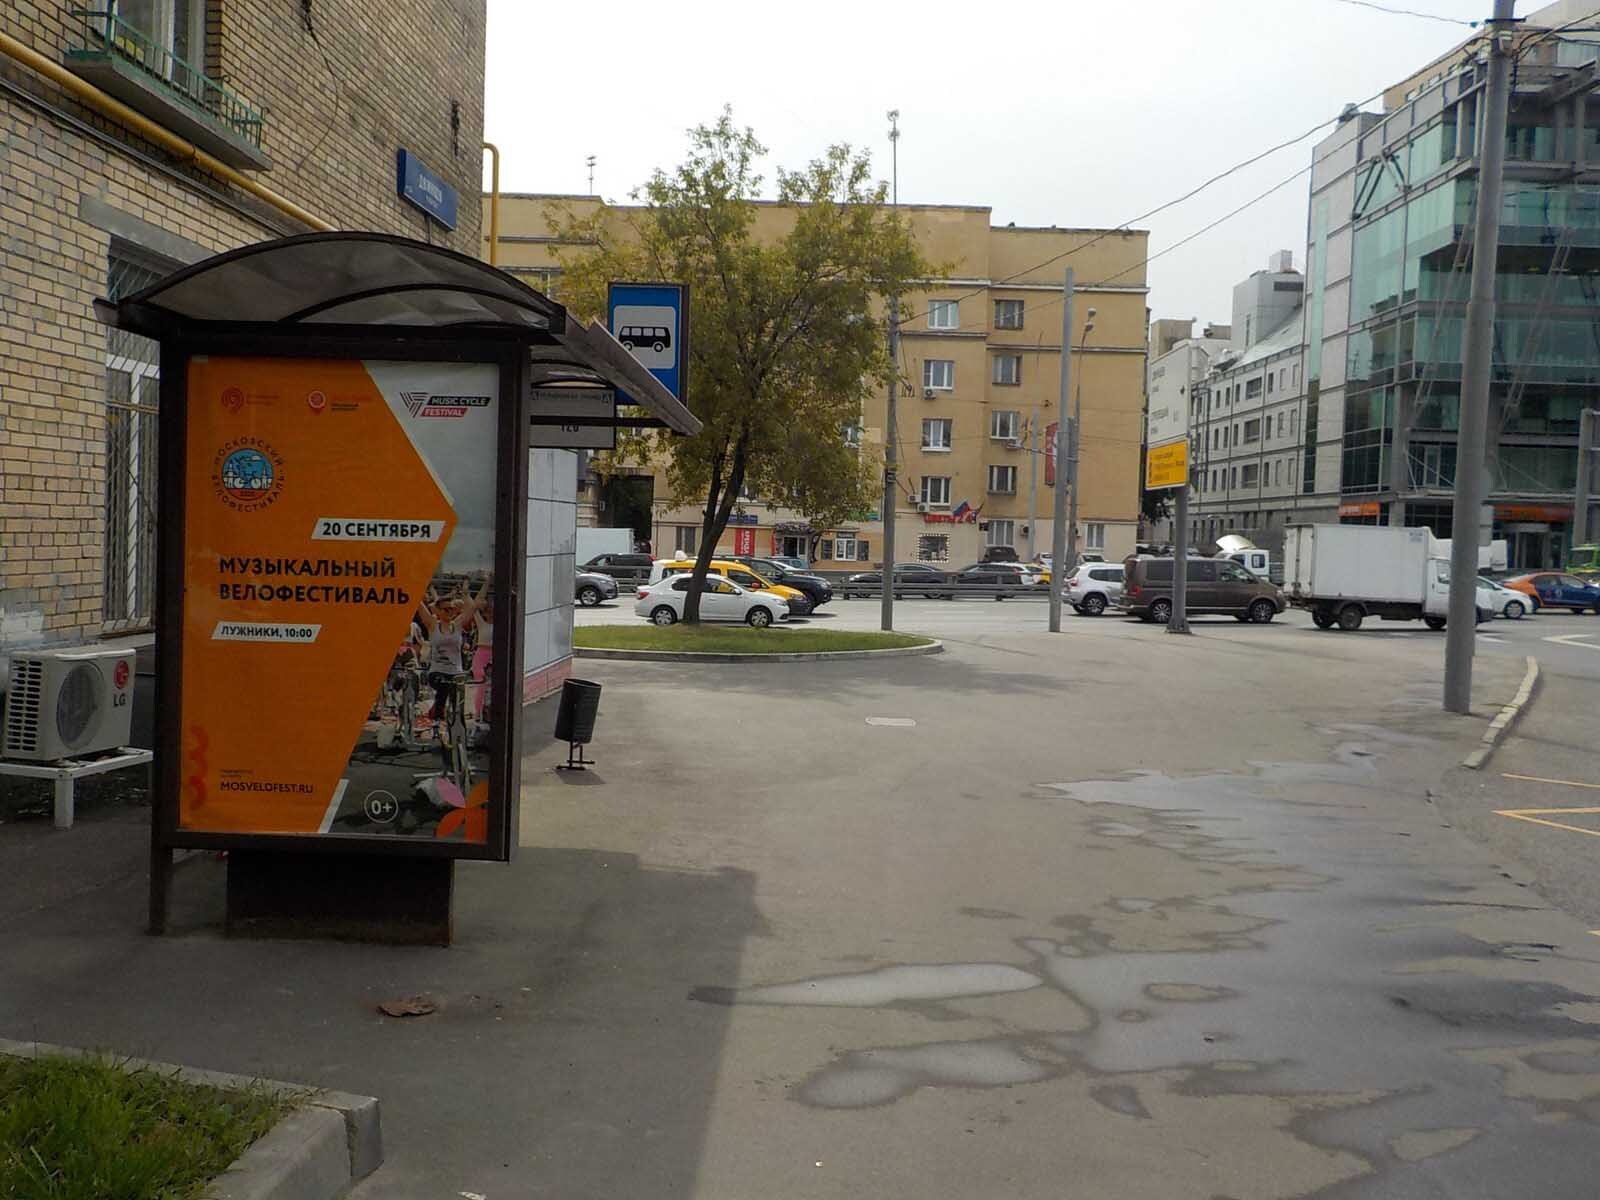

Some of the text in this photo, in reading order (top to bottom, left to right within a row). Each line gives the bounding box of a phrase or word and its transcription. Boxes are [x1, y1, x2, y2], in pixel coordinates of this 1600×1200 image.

[431, 397, 487, 406] MUSIC CYCLE
[424, 408, 462, 417] FESTIVAL
[213, 436, 283, 465] МОСКОВСКИЙ
[322, 522, 431, 538] 20 СЕНТЯБРЯ
[219, 557, 396, 578] МУЗЫКАЛЬНЫЙ
[219, 583, 410, 605] ВЕЛОФЕСТИВАЛЬ
[221, 624, 313, 639] ЛУЖНИКИ, 10:00
[113, 693, 127, 707] LG
[219, 781, 314, 795] MOSVELOFEST.RU
[371, 799, 393, 815] 0+
